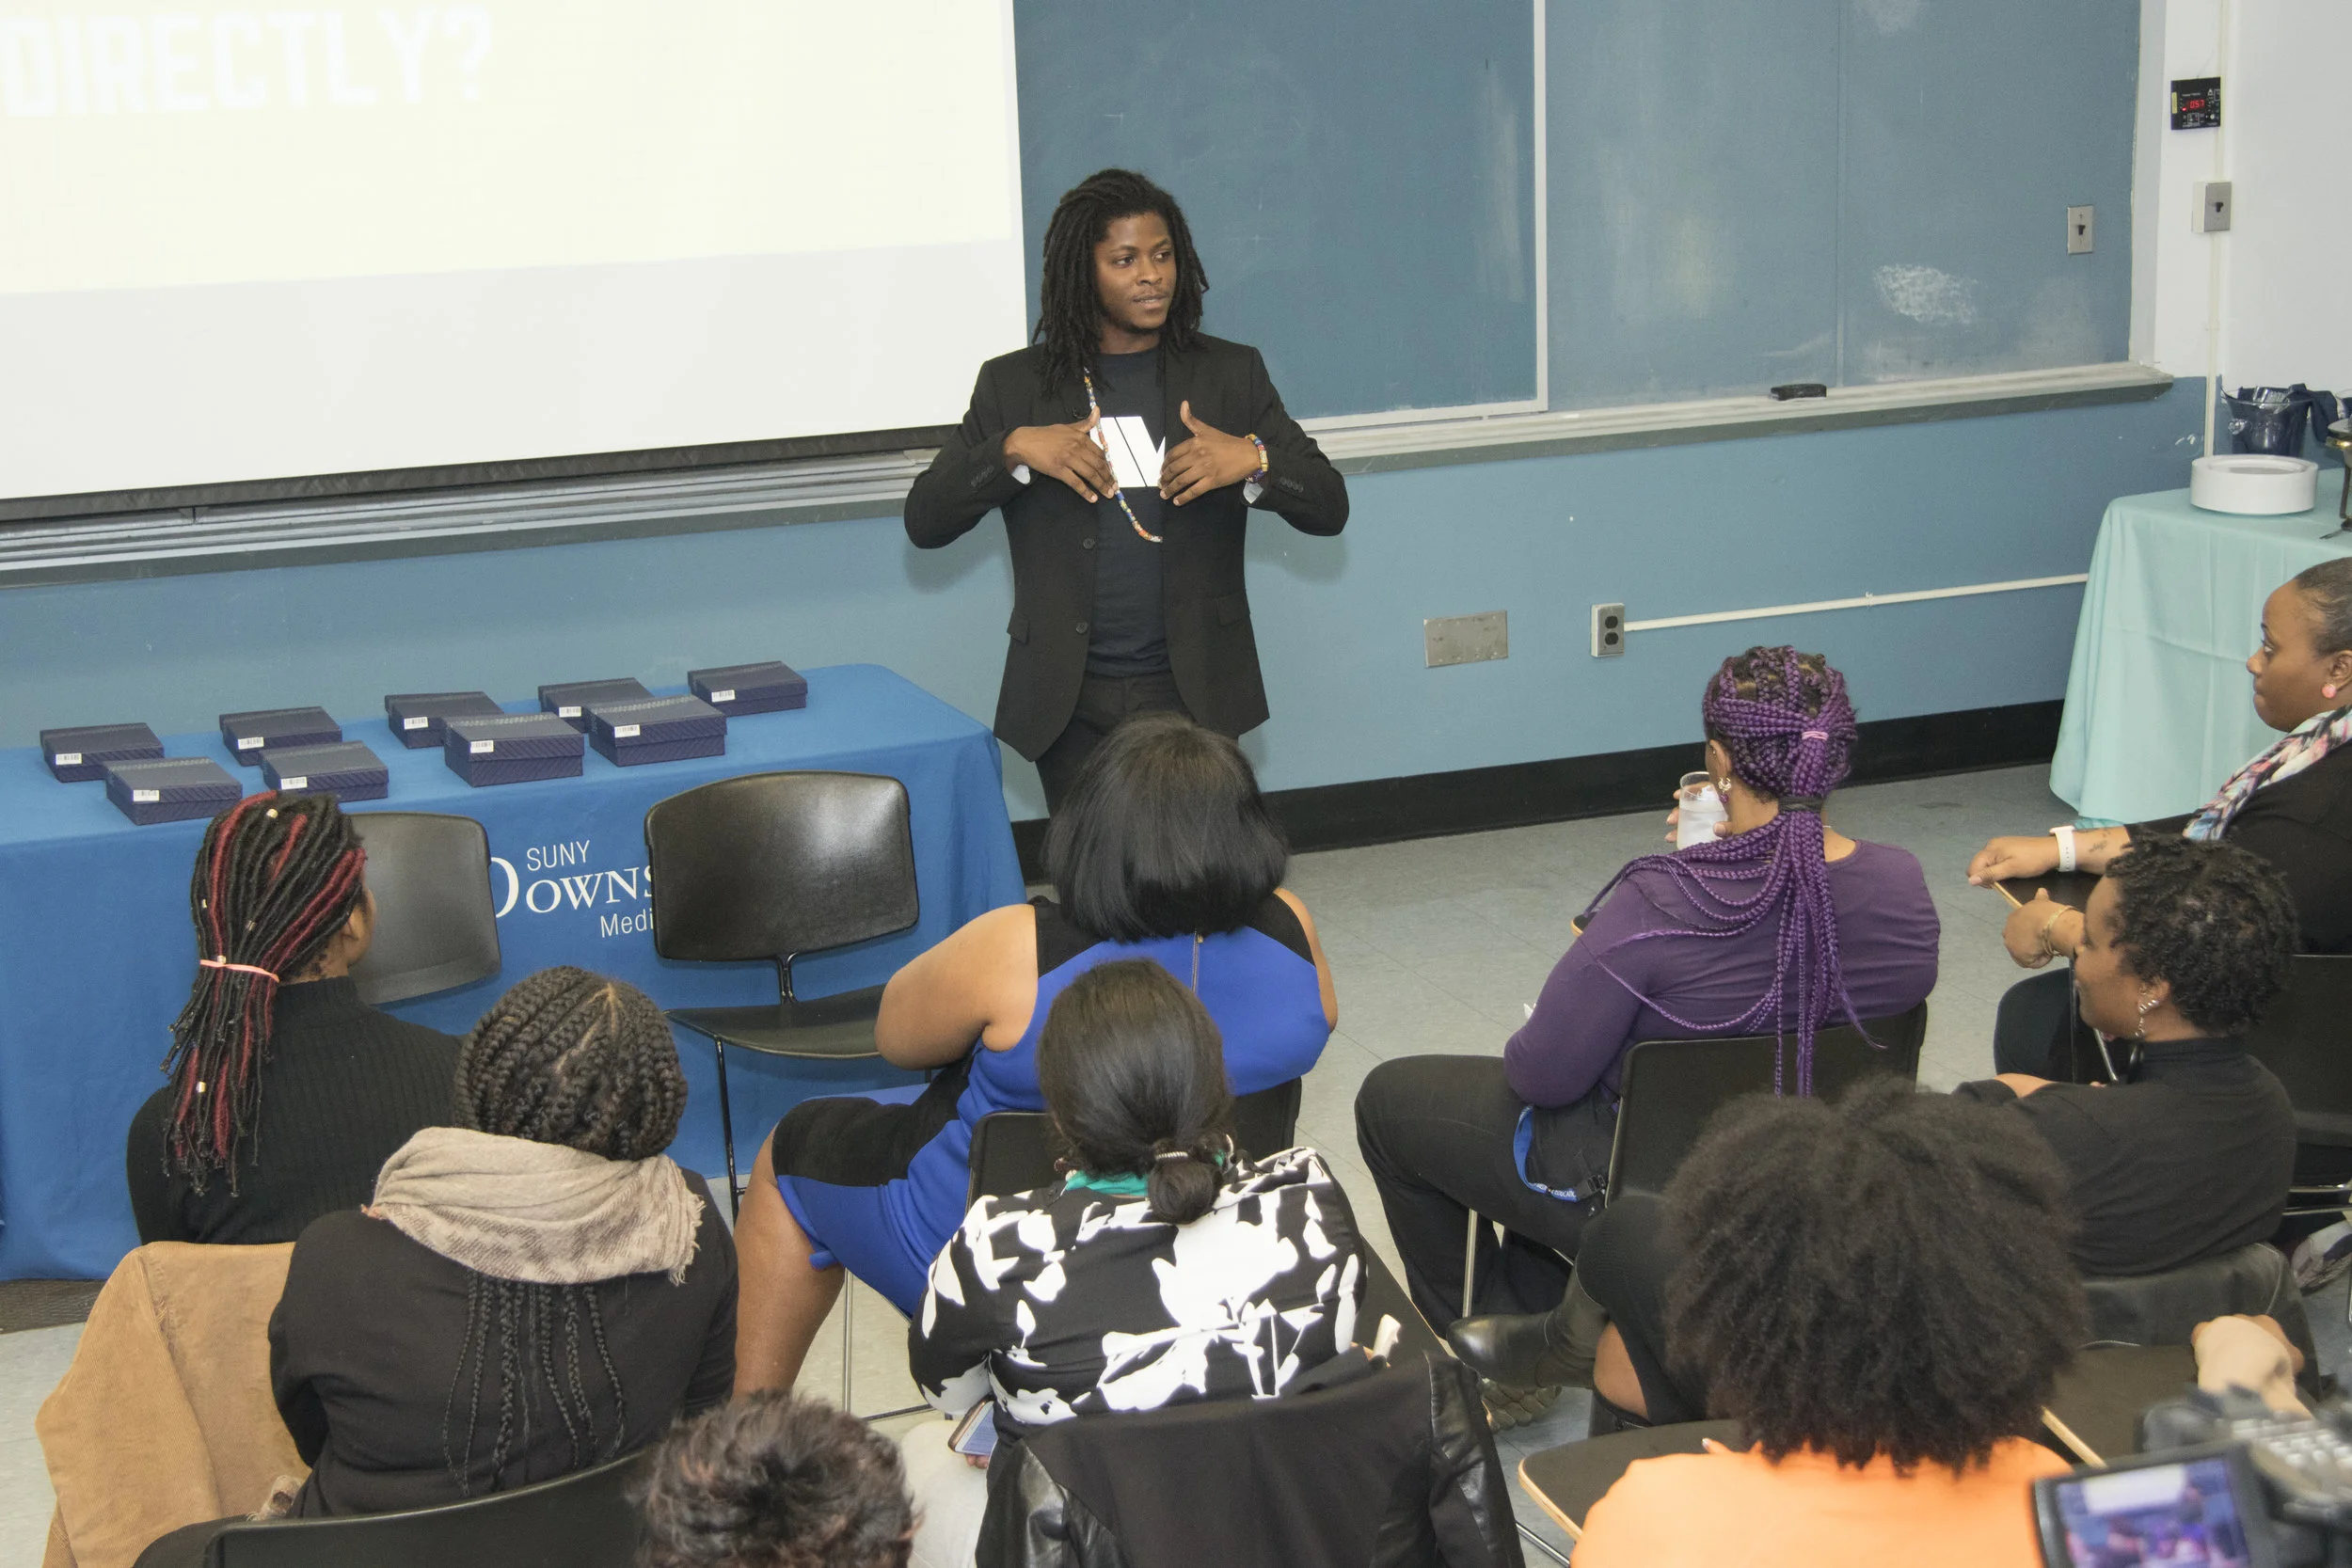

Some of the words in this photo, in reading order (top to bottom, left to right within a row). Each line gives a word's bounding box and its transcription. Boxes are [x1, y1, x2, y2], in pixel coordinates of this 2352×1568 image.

[1, 4, 493, 119] DIRECTLY?
[526, 840, 591, 872] SUNY
[600, 908, 654, 938] Medi
